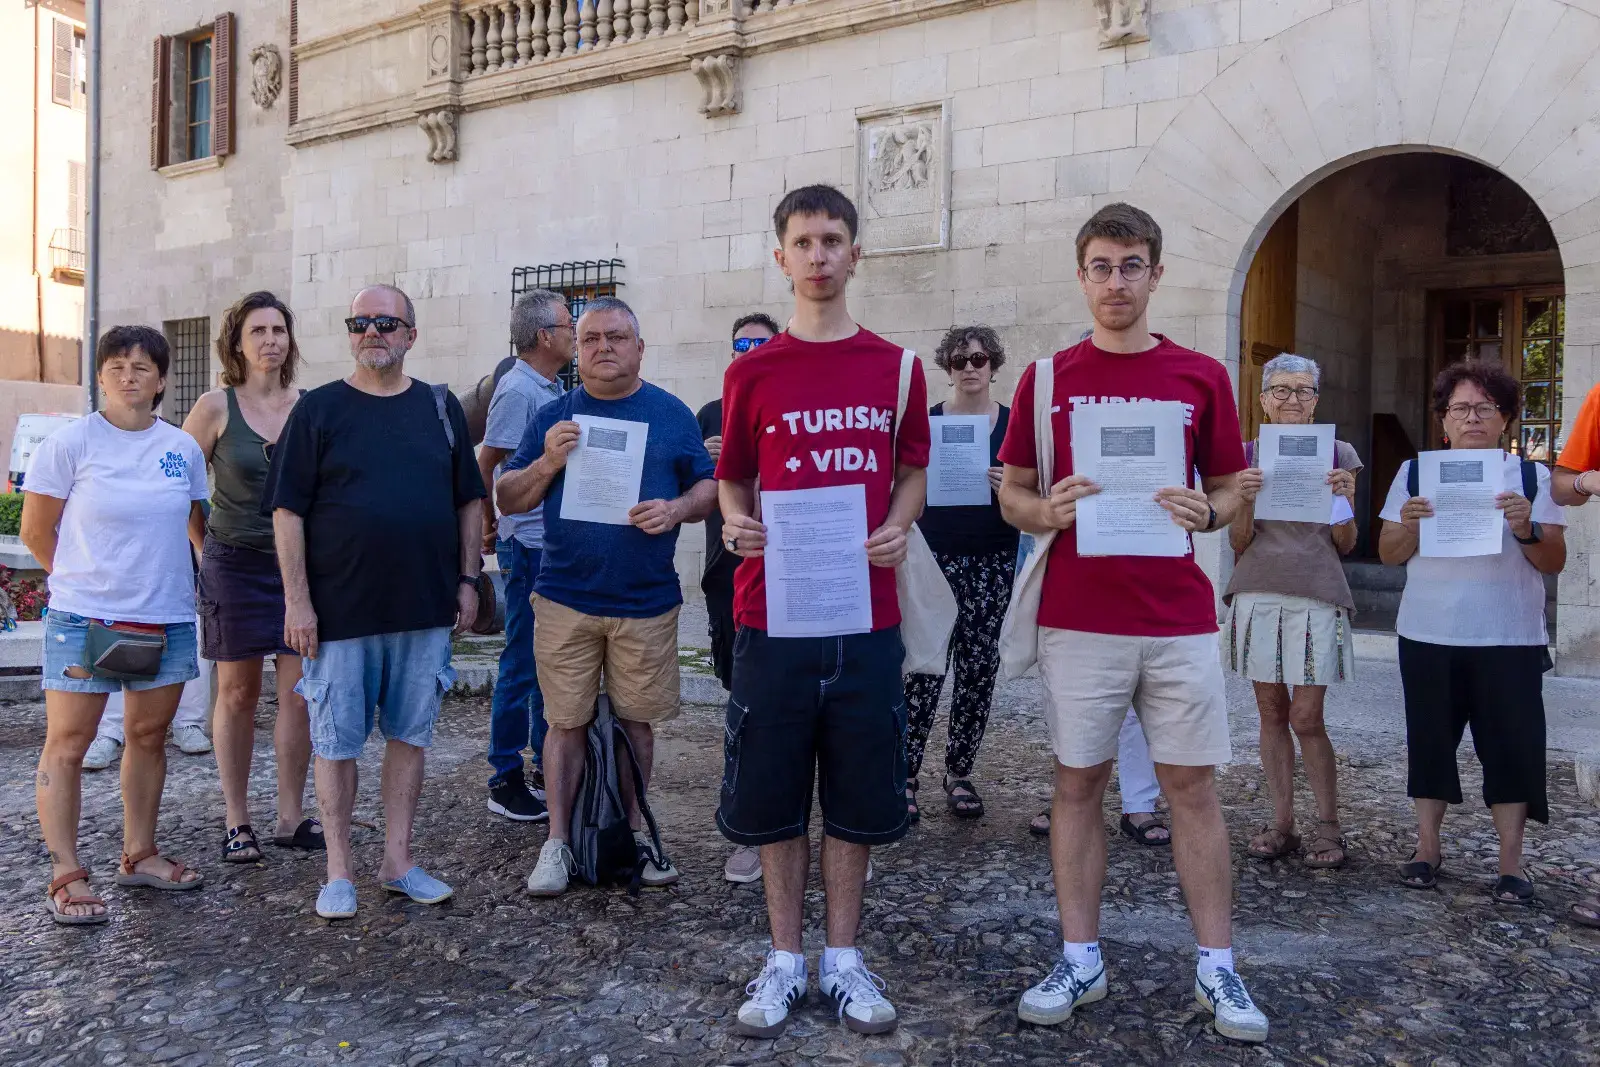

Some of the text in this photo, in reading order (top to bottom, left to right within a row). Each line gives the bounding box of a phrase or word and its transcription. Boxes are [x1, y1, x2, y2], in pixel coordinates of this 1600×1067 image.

[782, 406, 893, 435] TURISME
[165, 451, 184, 461] Red
[785, 447, 878, 472] + VIDA
